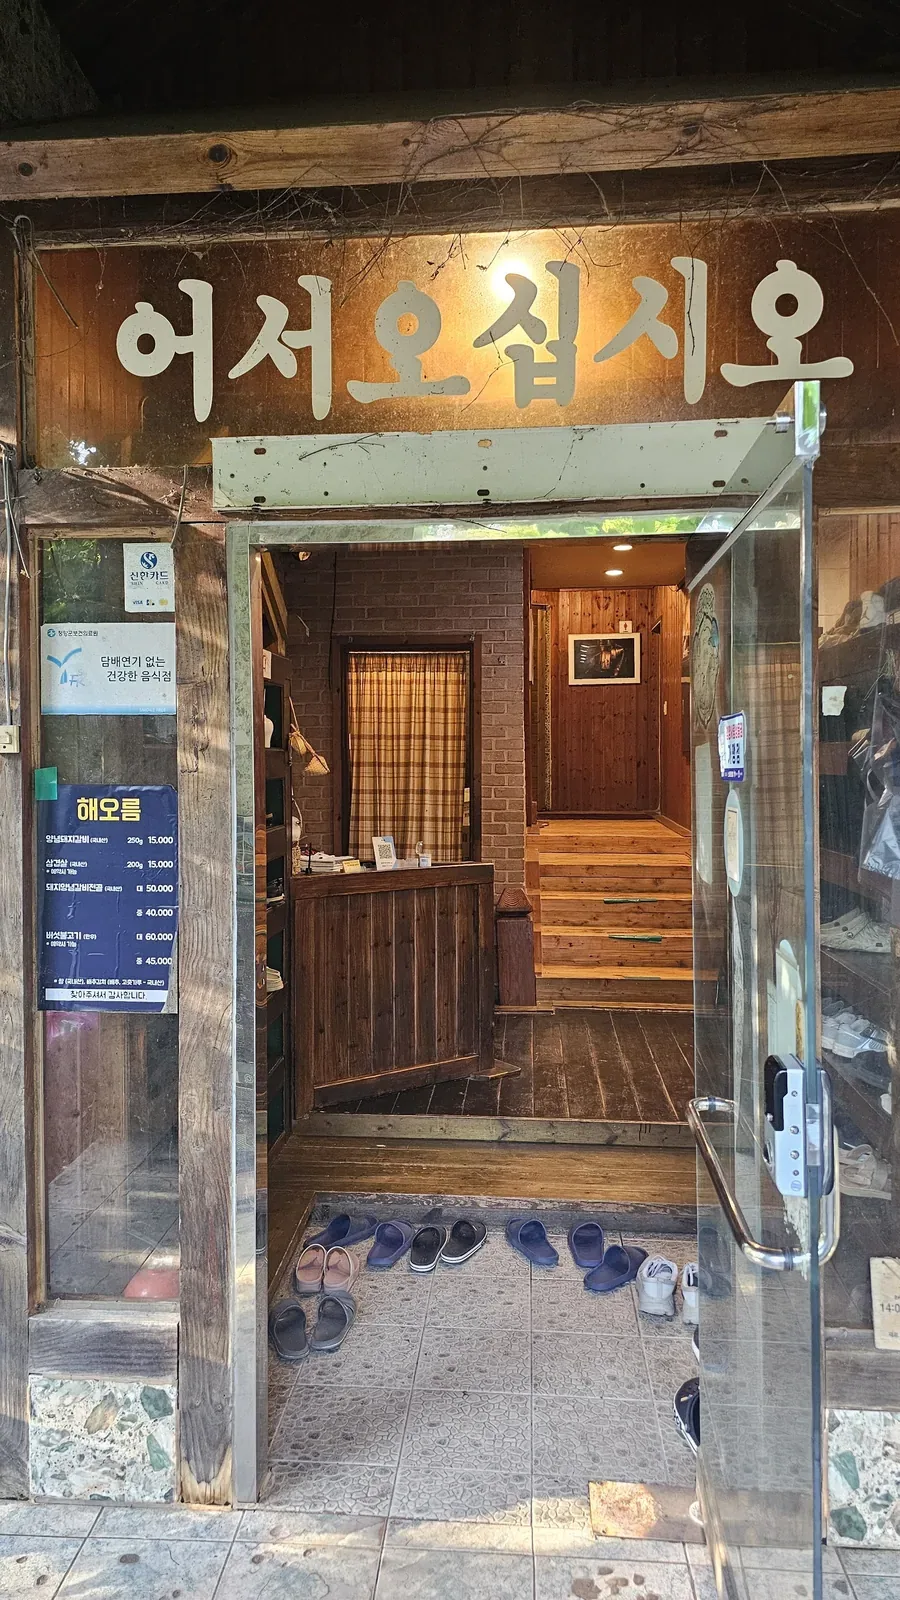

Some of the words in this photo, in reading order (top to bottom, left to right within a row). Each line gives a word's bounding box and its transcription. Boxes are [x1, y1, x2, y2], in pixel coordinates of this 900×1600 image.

[116, 256, 854, 422] 어서오십시오
[101, 656, 141, 668] 담배연기
[146, 656, 166, 668] 없는
[107, 671, 137, 682] 건강한
[141, 671, 172, 682] 음식점
[77, 797, 141, 821] 해오름
[127, 837, 143, 845] 250g
[148, 836, 173, 844] 15,000
[46, 859, 68, 867] 삼겹살
[127, 861, 143, 869] 200g
[148, 860, 173, 868] 15,000
[146, 884, 173, 892] 50,000
[46, 931, 82, 940] 버섯불고기
[145, 957, 173, 965] 45,000
[70, 990, 107, 999] 찾아주셔서
